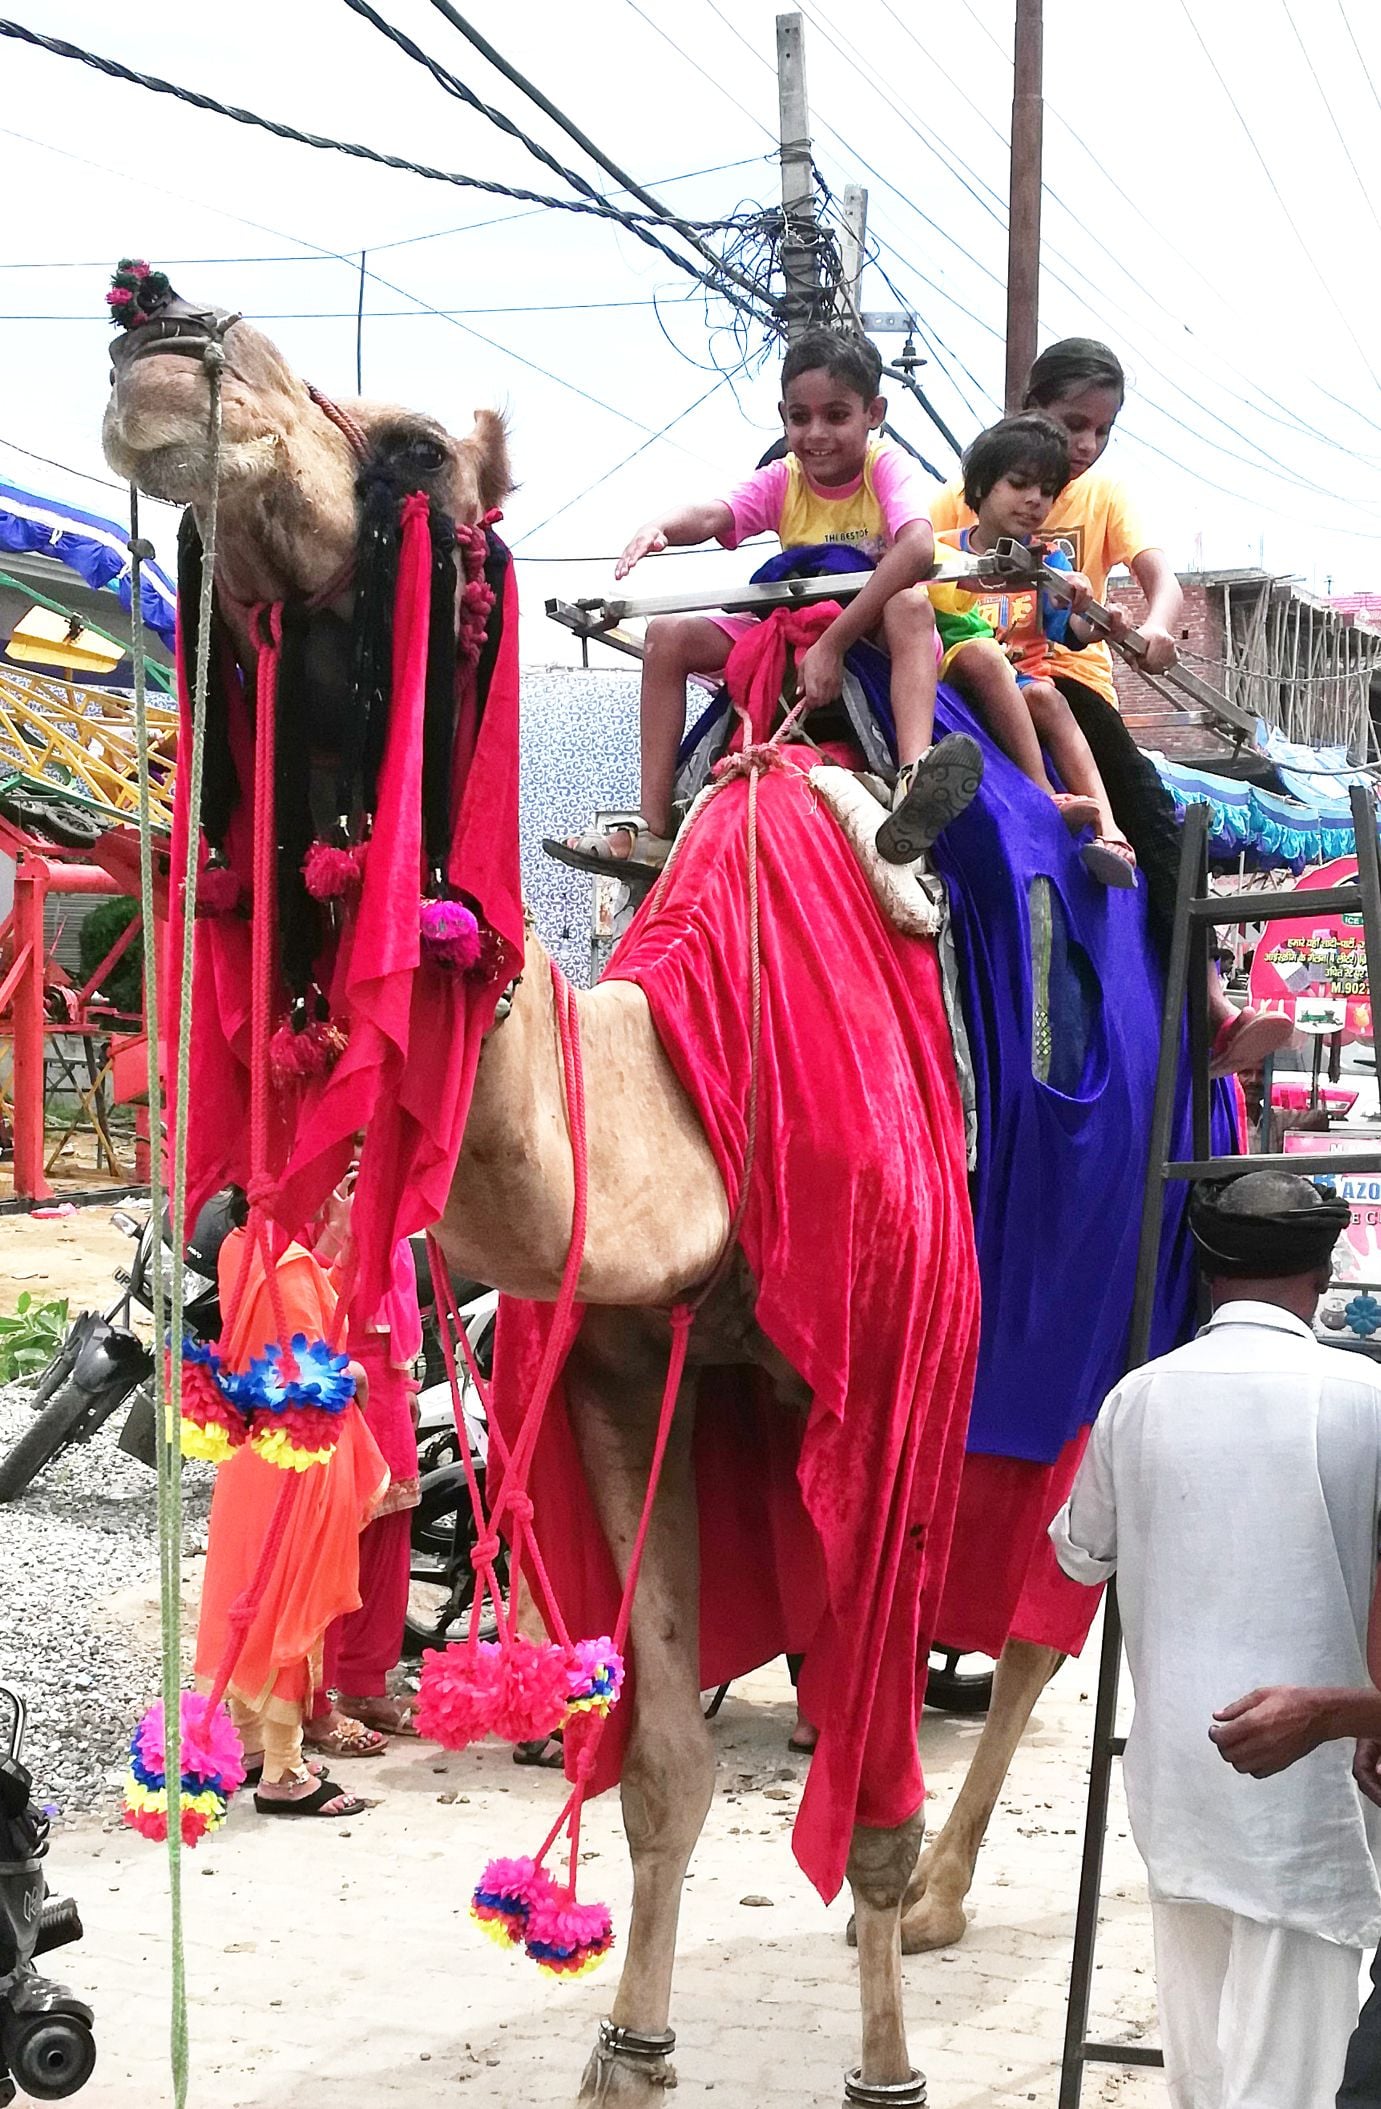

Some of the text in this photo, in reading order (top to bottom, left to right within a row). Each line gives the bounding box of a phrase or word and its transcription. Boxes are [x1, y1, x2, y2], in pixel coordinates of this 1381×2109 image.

[840, 531, 859, 541] BEST
[1344, 917, 1360, 925] ICE
[1367, 1212, 1381, 1225] C
